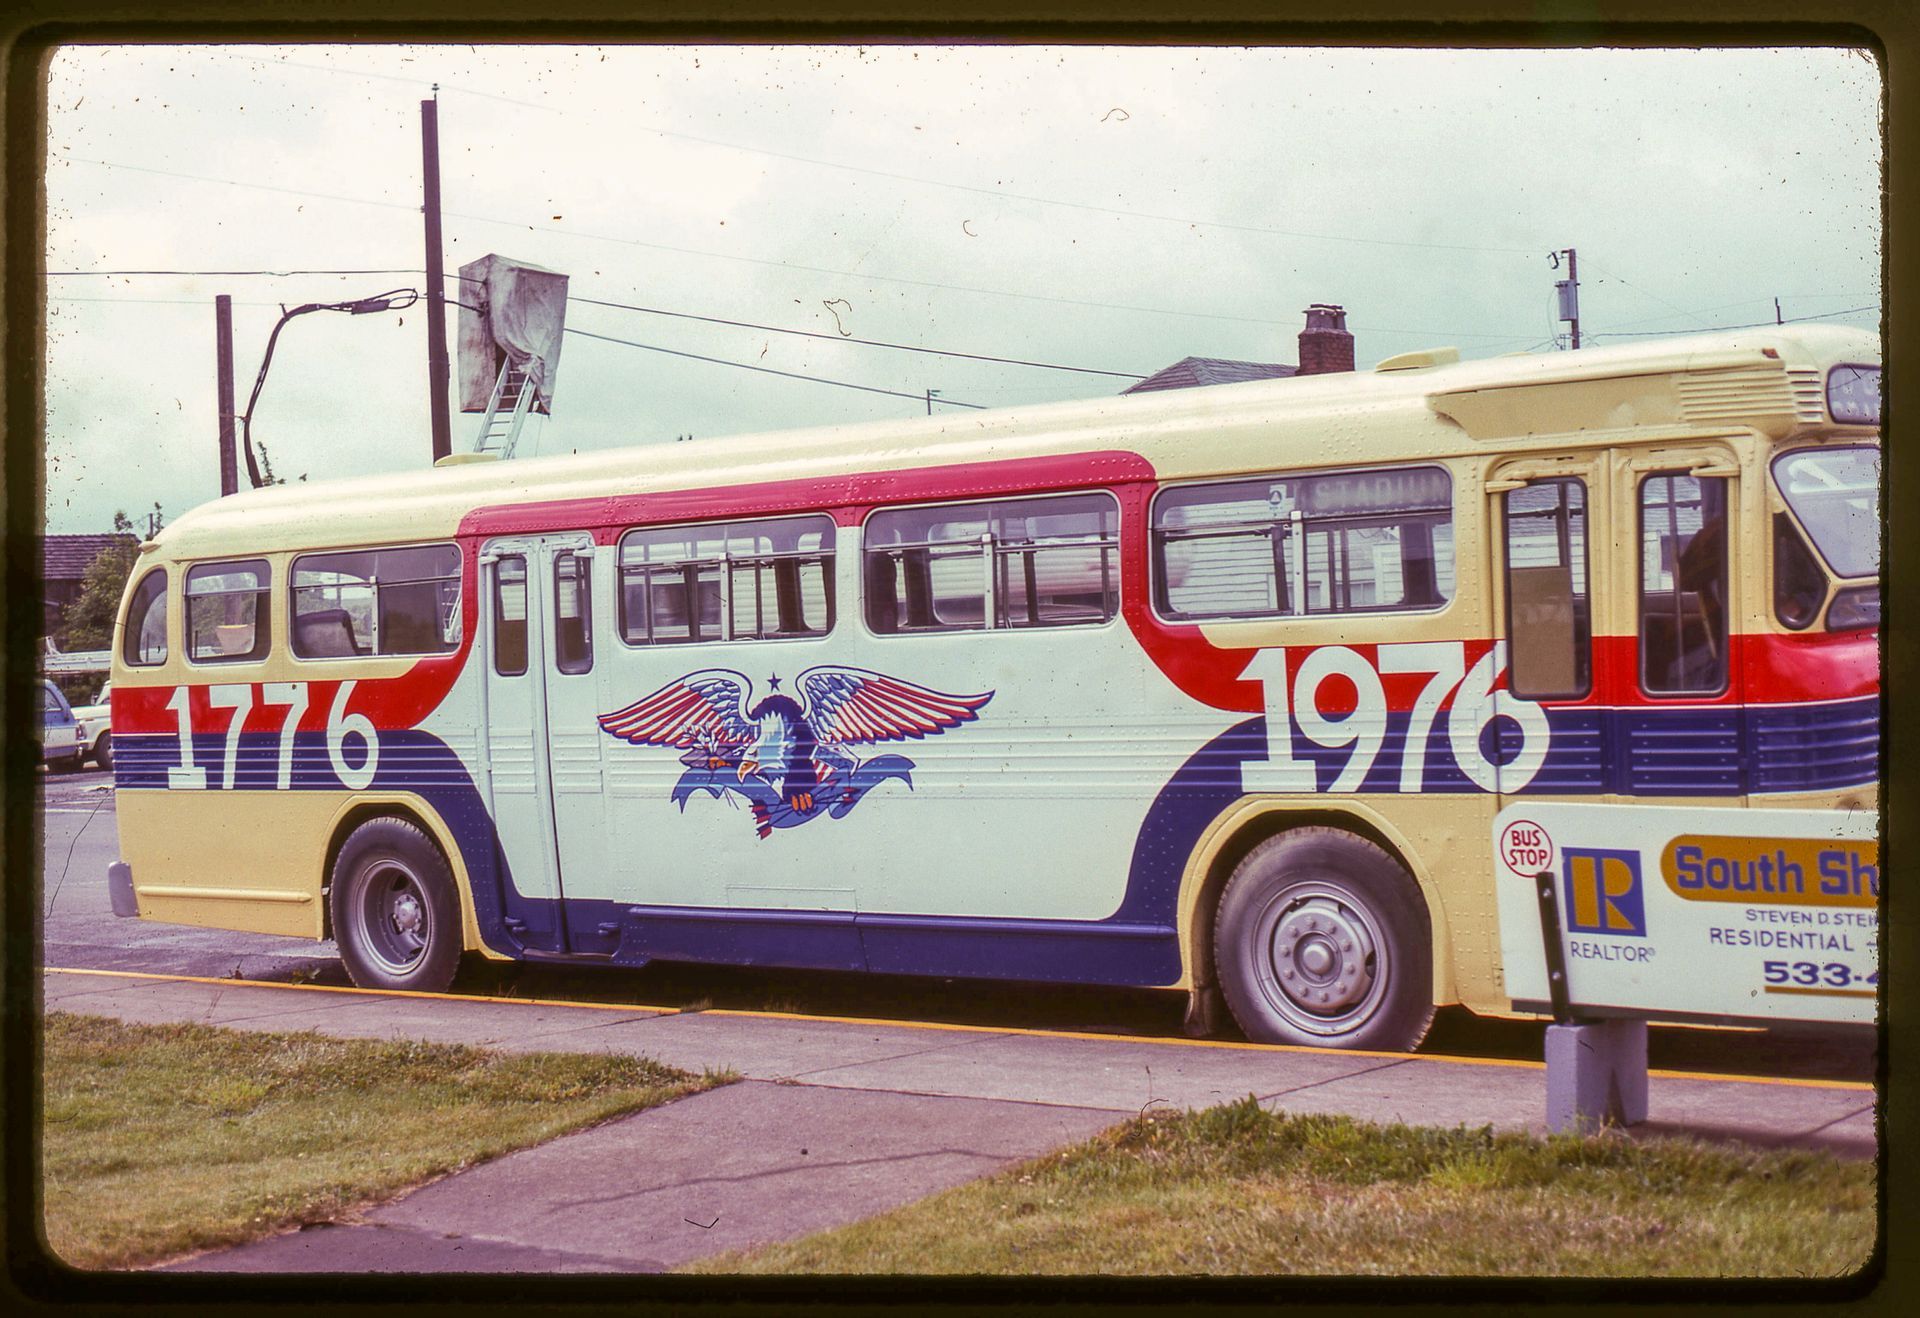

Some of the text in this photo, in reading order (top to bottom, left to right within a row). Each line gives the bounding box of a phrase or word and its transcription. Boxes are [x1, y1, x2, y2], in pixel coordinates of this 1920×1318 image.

[164, 680, 379, 790] 1776
[1235, 640, 1550, 794] 1976
[1511, 830, 1541, 848] BUS
[1510, 848, 1548, 867] STOP
[1675, 844, 1804, 893] South
[1570, 855, 1636, 931] R
[1745, 908, 1813, 924] STEVEN
[1709, 928, 1855, 952] RESIDENTIAL
